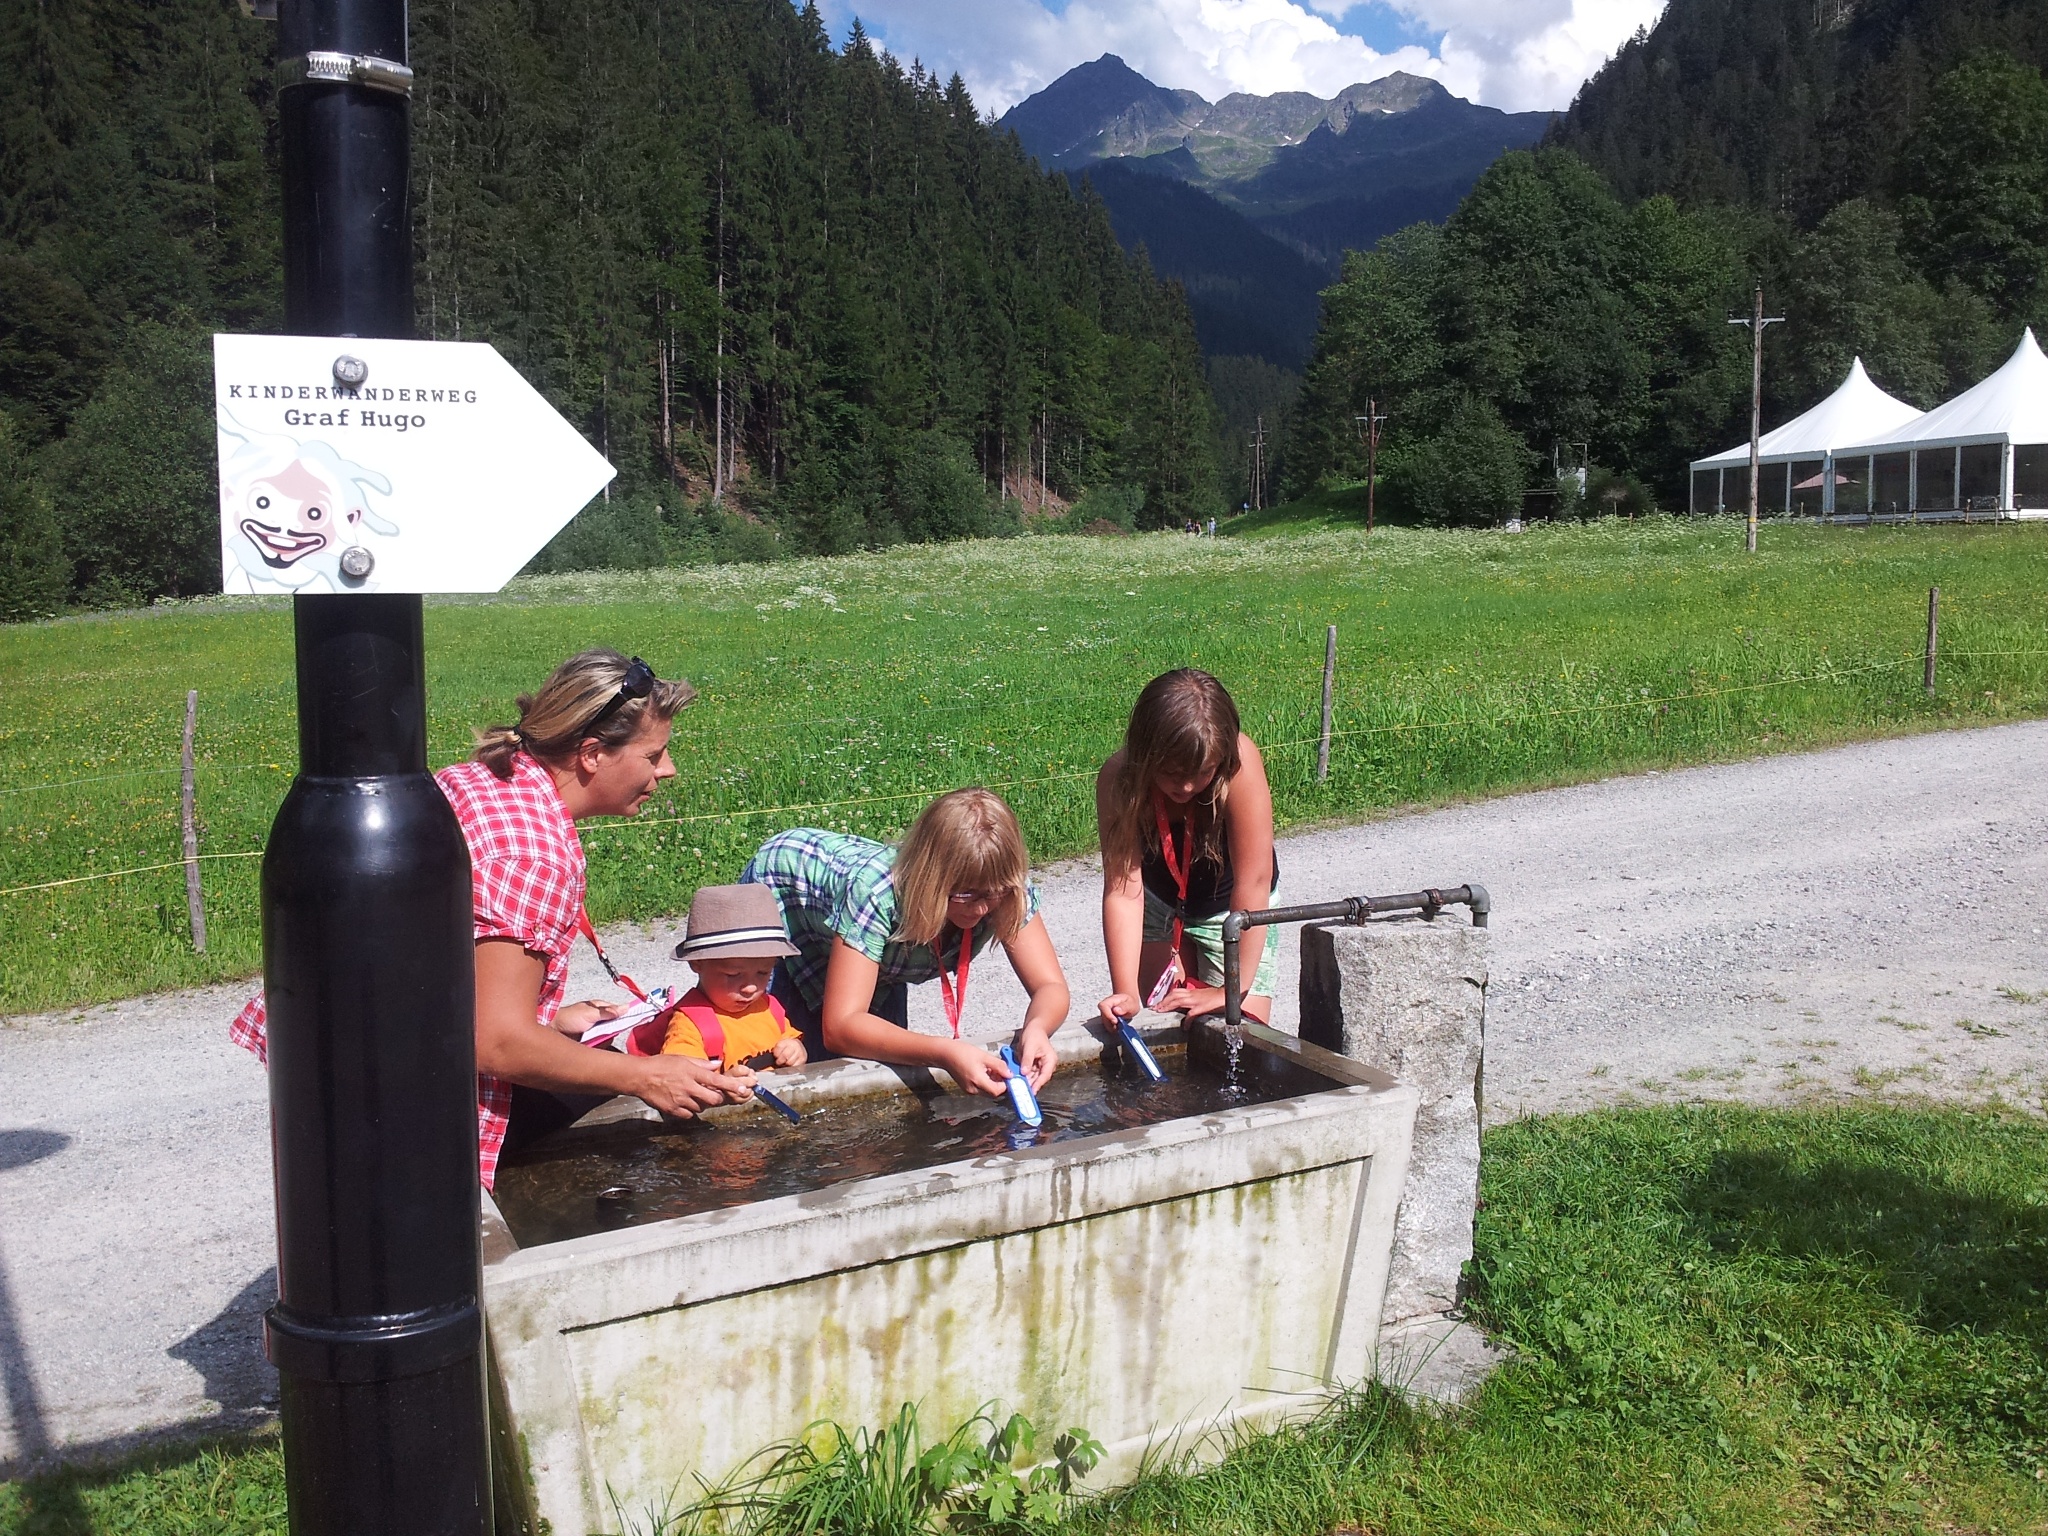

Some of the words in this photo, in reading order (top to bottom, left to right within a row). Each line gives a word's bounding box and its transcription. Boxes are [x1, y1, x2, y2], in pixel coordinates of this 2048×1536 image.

[229, 384, 478, 404] KINDERWANDERWEG
[284, 409, 350, 426] Graf
[360, 410, 426, 433] Hugo
